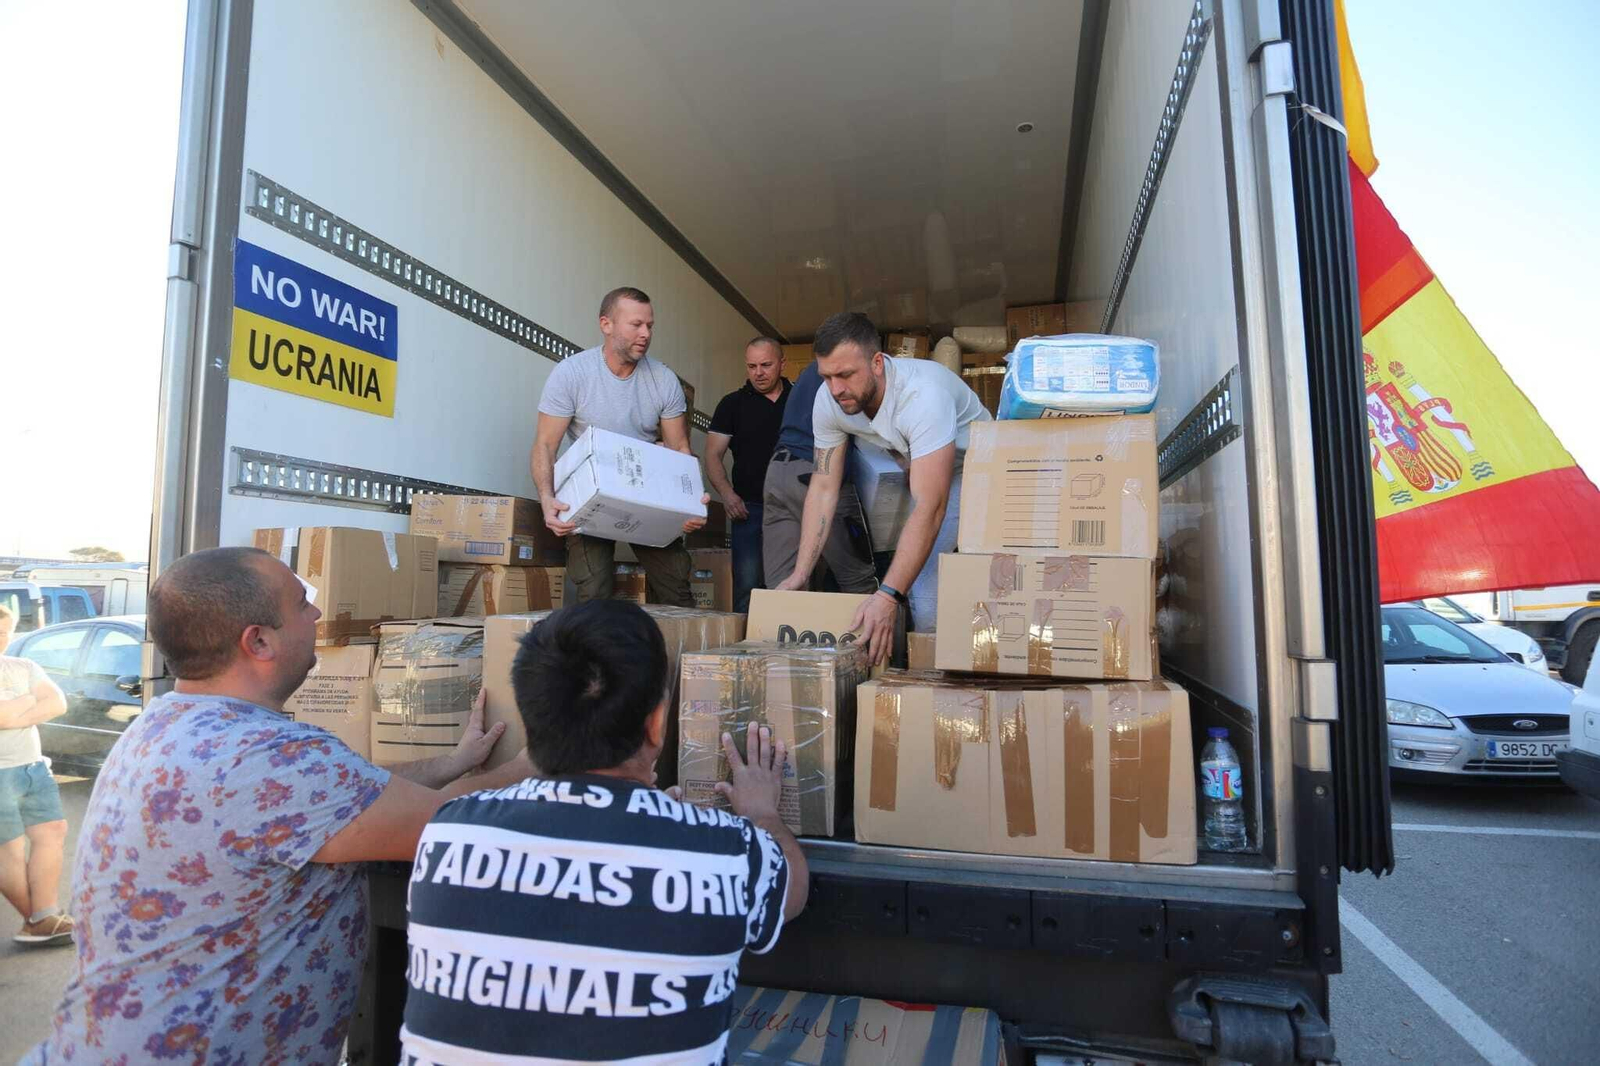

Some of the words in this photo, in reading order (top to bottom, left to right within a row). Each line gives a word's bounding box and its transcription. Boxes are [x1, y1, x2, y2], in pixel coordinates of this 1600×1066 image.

[251, 264, 302, 308] NO
[311, 288, 387, 341] WAR!
[248, 329, 382, 402] UCRANIA
[1501, 743, 1538, 757] 9852
[431, 842, 633, 907] ADIDAS
[409, 944, 687, 1018] ORIGINALS
